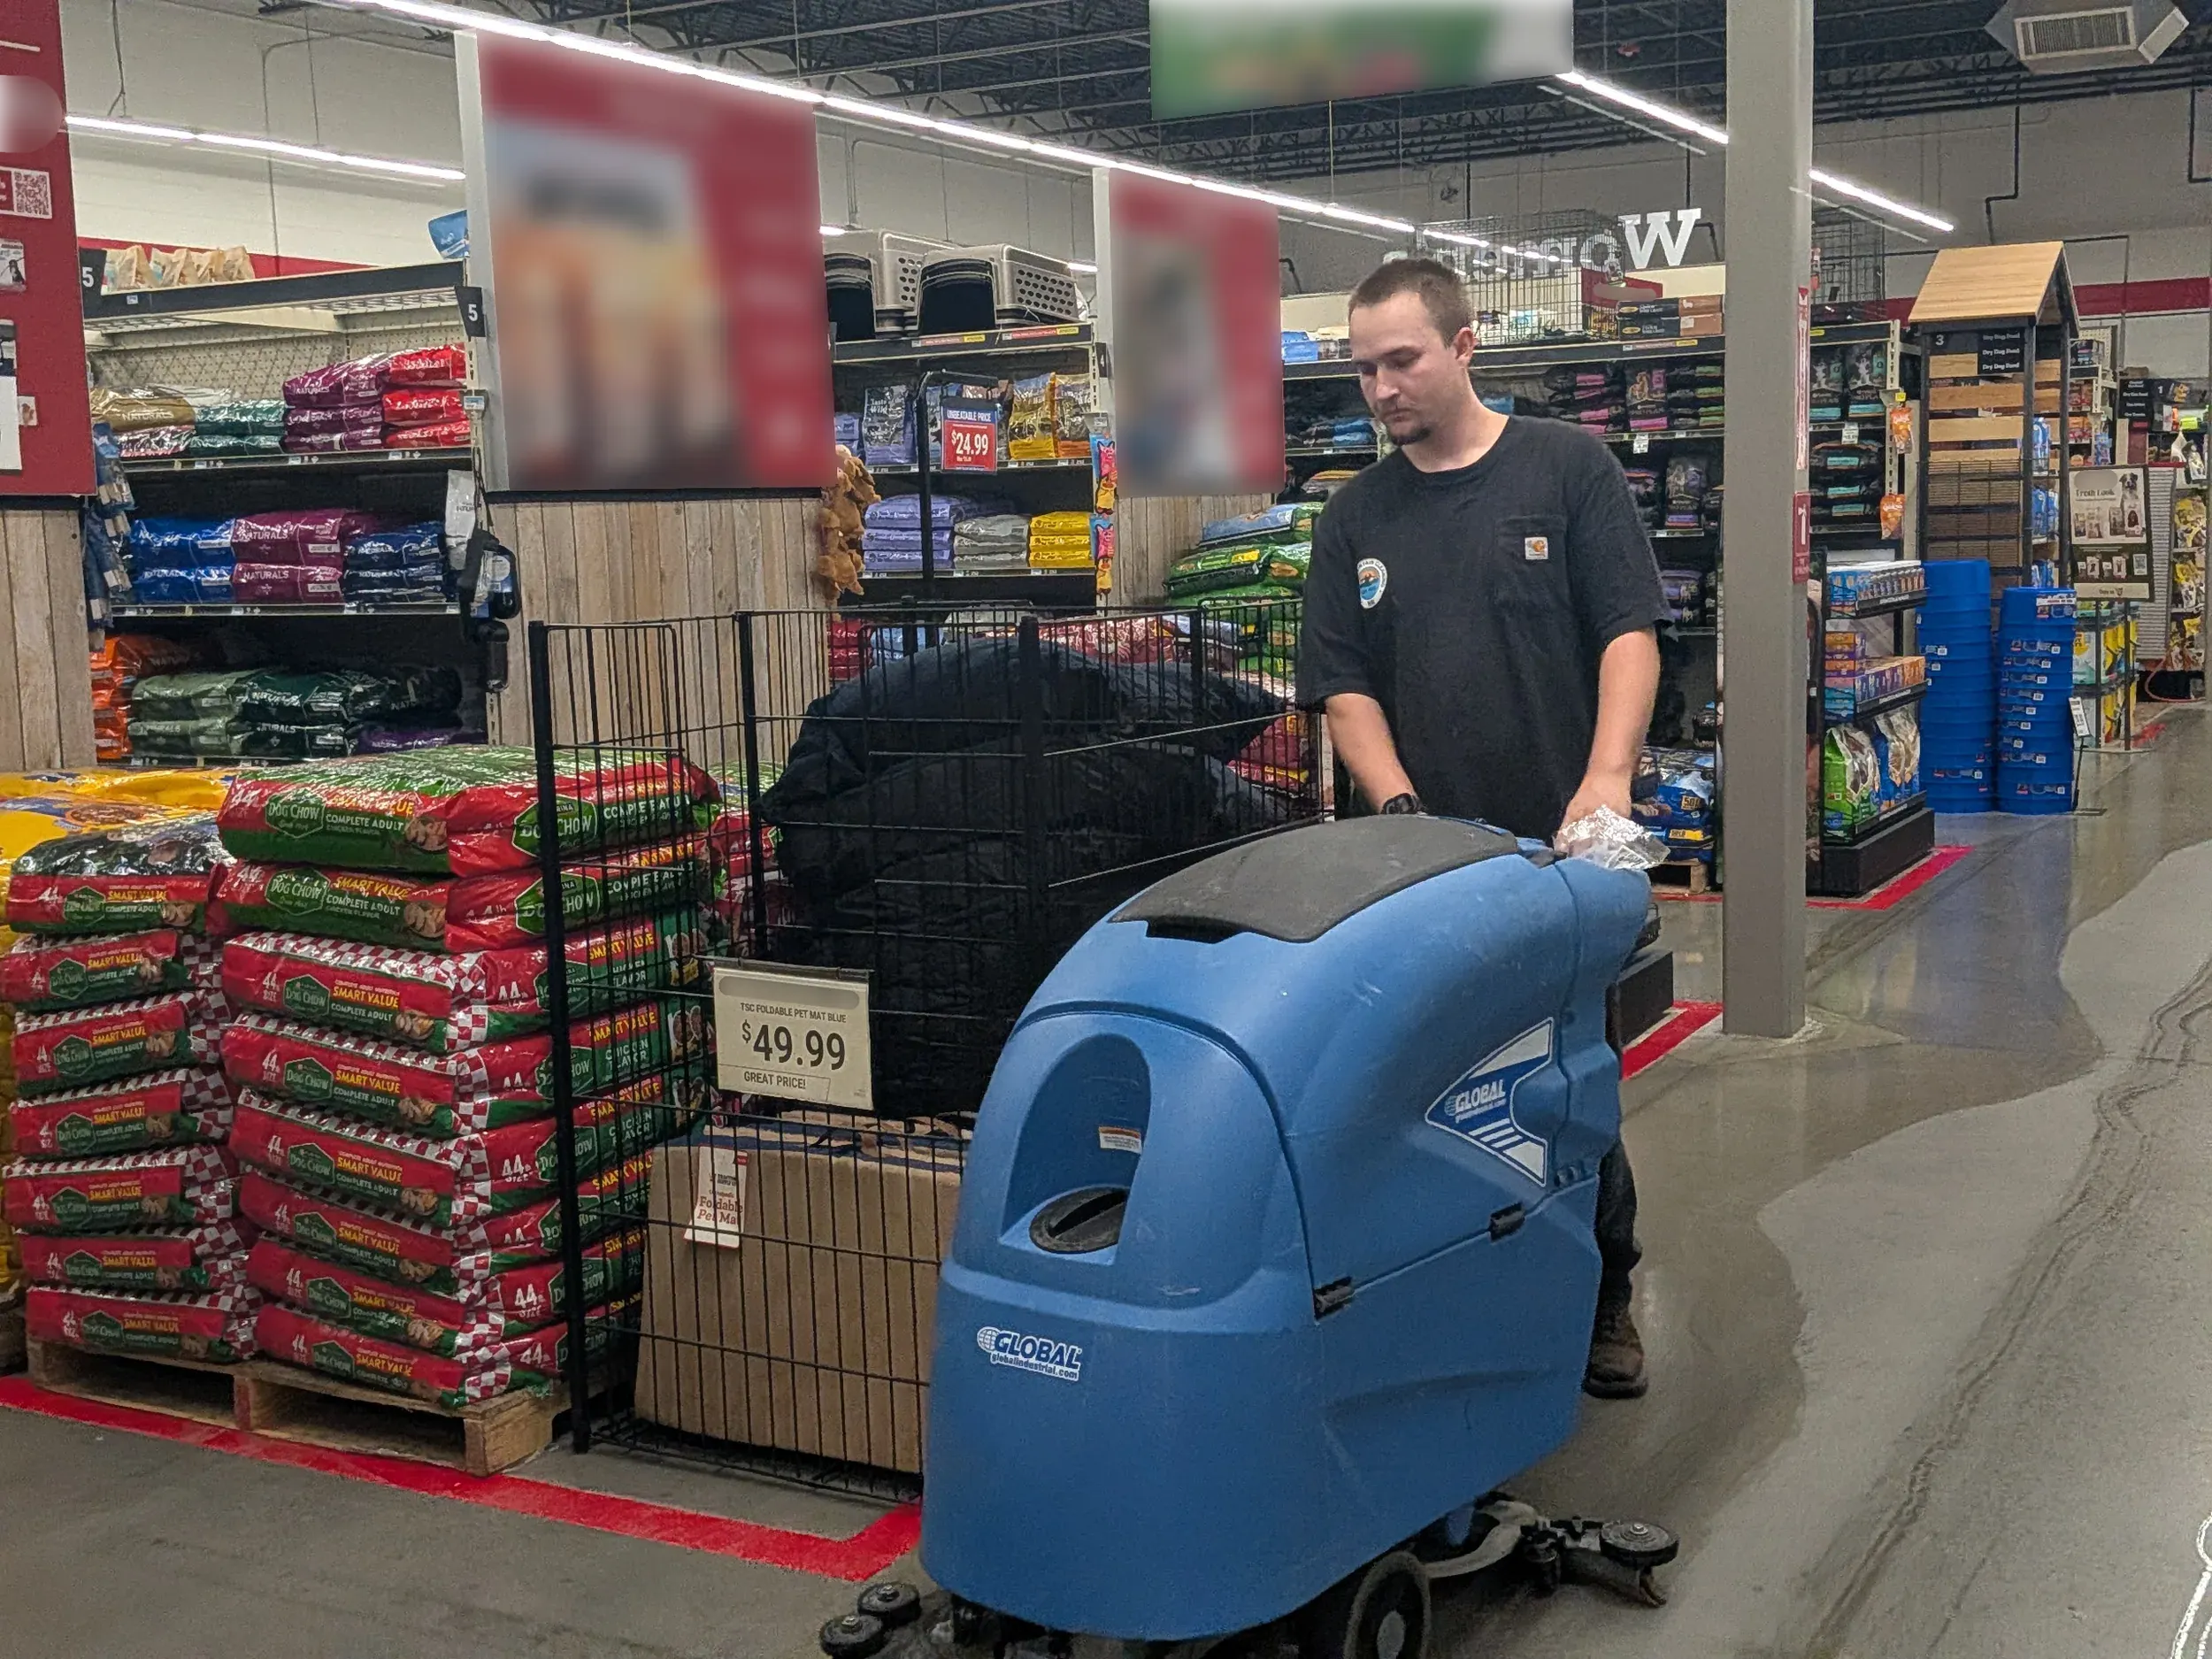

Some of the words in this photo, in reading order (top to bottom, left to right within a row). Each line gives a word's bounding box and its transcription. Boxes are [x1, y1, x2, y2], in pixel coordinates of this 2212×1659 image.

[82, 267, 94, 288] 5
[468, 304, 478, 321] 5
[1935, 334, 1945, 346] 3
[1100, 355, 1105, 367] 4
[2157, 386, 2163, 395] 1
[977, 412, 991, 422] PRICE
[951, 430, 988, 456] $24.99
[242, 531, 288, 541] NATURALS
[243, 571, 289, 580] NATURALS
[268, 803, 288, 817] DOG
[290, 804, 320, 820] CHOW
[326, 814, 369, 827] COMPLETE
[372, 818, 403, 831] ADULT
[519, 825, 541, 837] DO
[557, 815, 592, 837] CHOW
[108, 890, 134, 901] SMART
[272, 879, 289, 895] DOG
[291, 882, 322, 900] CHOW
[335, 876, 373, 891] SMART
[374, 881, 411, 898] VALUE
[326, 895, 369, 910] COMPLETE
[371, 902, 400, 916] ADULT
[88, 957, 114, 968] SMART
[263, 972, 277, 988] 44
[285, 987, 302, 1001] DOG
[303, 989, 326, 1007] CHOW
[333, 987, 365, 1003] SMART
[367, 992, 399, 1008] VALUE
[331, 1002, 365, 1018] COMPLETE
[368, 1010, 393, 1021] ADULT
[741, 1002, 755, 1012] TSC
[757, 1004, 792, 1017] FOLDABLE
[795, 1009, 808, 1018] PET
[810, 1010, 826, 1021] MAT
[828, 1013, 847, 1023] BLUE
[93, 1031, 119, 1044] SMART
[120, 1026, 146, 1039] VALUE
[741, 1019, 845, 1071] $49.99
[262, 1052, 277, 1071] 44
[286, 1071, 303, 1085] DOG
[305, 1073, 329, 1090] CHOW
[336, 1071, 368, 1088] SMART
[369, 1077, 401, 1094] VALUE
[744, 1071, 773, 1085] GREAT
[777, 1076, 806, 1089] PRICE!
[334, 1087, 369, 1102] COMPLETE
[371, 1094, 396, 1107] ADULT
[1455, 1079, 1506, 1114] GLOBAL
[94, 1113, 119, 1124] SMART
[120, 1108, 145, 1118] VALUE
[267, 1135, 281, 1152] 44
[307, 1160, 331, 1176] CHOW
[337, 1156, 369, 1174] SMART
[370, 1165, 402, 1182] VALUE
[502, 1155, 524, 1177] 44
[89, 1189, 115, 1201] SMART
[116, 1186, 142, 1196] VALUE
[335, 1173, 372, 1189] COMPLETE
[374, 1184, 398, 1196] ADULT
[274, 1204, 288, 1223] 44
[700, 1196, 742, 1213] Fodable
[719, 1212, 736, 1225] Ma
[338, 1227, 370, 1246] SMART
[371, 1237, 400, 1255] VALUE
[103, 1256, 129, 1266] SMART
[286, 1268, 301, 1286] 44
[325, 1294, 347, 1310] CHOW
[353, 1292, 386, 1308] SMART
[515, 1284, 538, 1308] 44
[124, 1318, 151, 1329] SMART
[292, 1334, 306, 1351] 44
[995, 1333, 1079, 1370] GLOBAL
[356, 1355, 387, 1371] SMART
[992, 1353, 1077, 1379] globalindustrial.com
